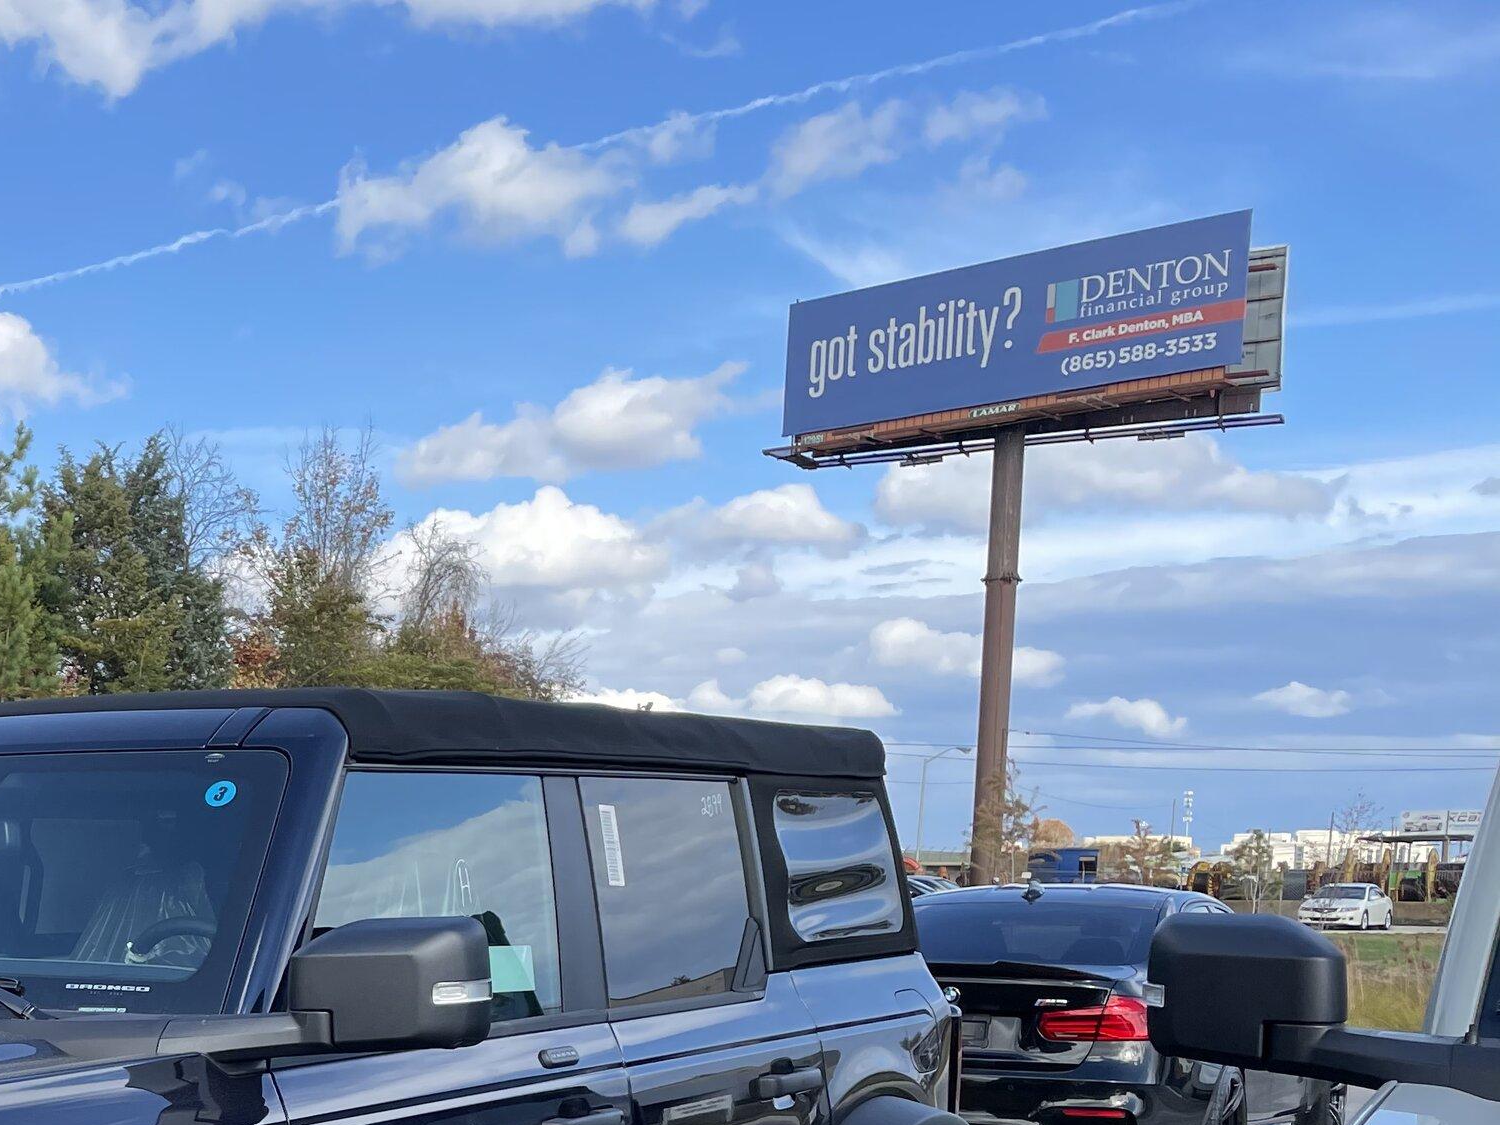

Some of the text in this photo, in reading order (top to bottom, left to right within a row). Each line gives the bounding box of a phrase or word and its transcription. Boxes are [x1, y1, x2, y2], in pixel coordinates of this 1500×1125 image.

[1081, 249, 1232, 303] DENTON
[1079, 281, 1228, 318] financial group
[809, 287, 1022, 398] got stability?
[1068, 310, 1204, 344] F. Clark Denton, MBA
[1060, 332, 1217, 376] (865) 588-3533
[972, 404, 1019, 418] LAMAR
[214, 786, 228, 801] 3
[65, 983, 150, 992] BRONCO
